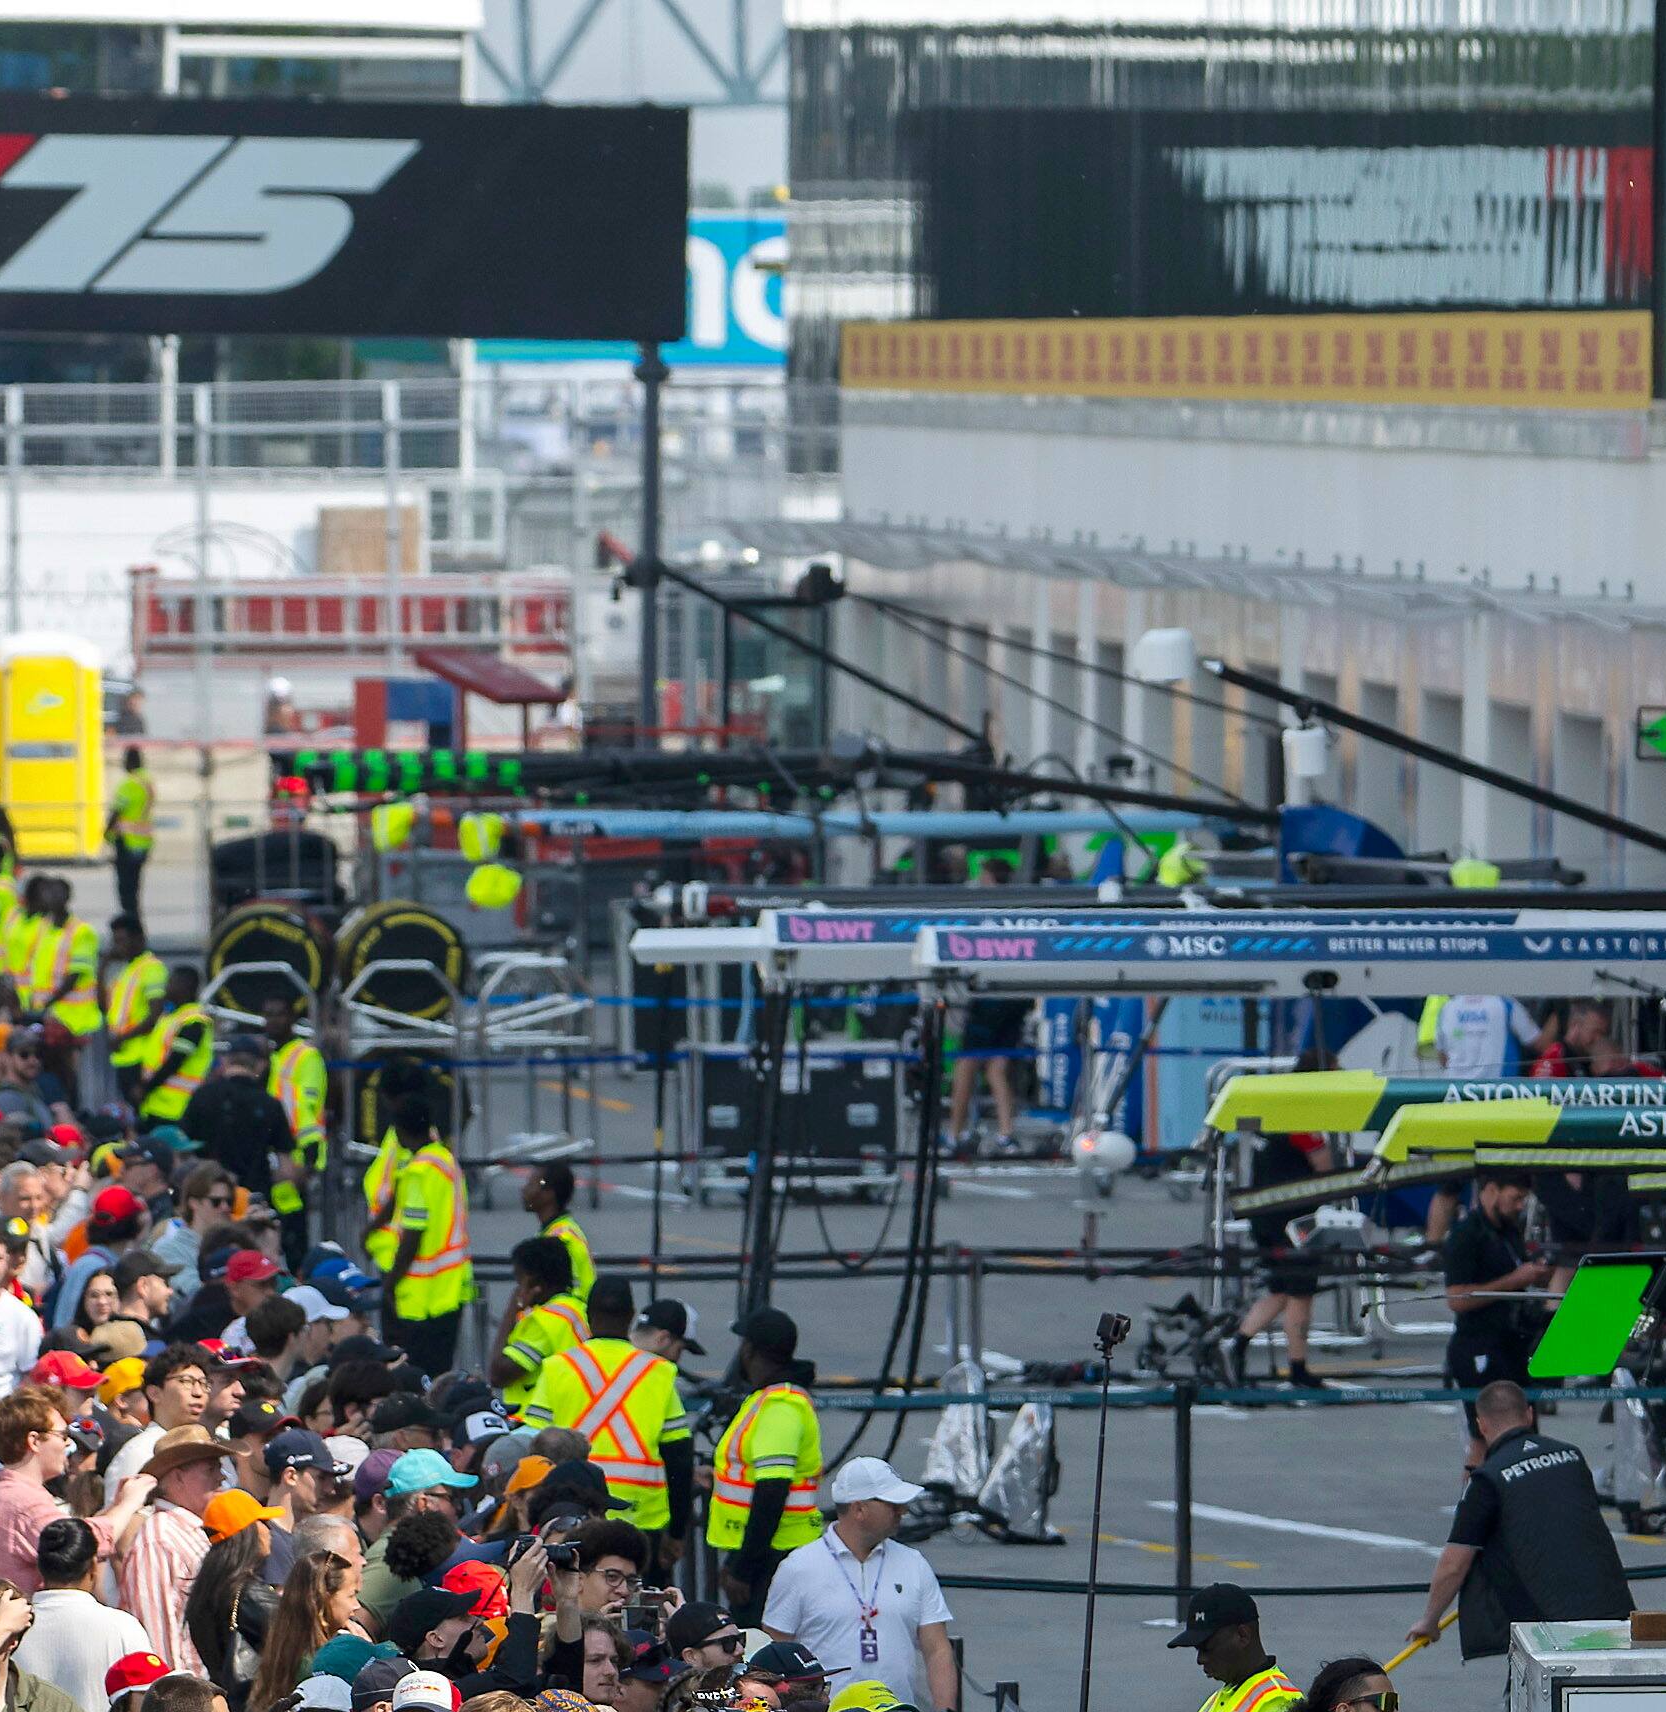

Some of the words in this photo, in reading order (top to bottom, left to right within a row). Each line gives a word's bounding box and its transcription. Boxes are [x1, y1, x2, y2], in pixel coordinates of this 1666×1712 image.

[1168, 936, 1226, 956] MSC
[1552, 1083, 1666, 1107] MARTIN
[1501, 1449, 1580, 1483] PETRONAS
